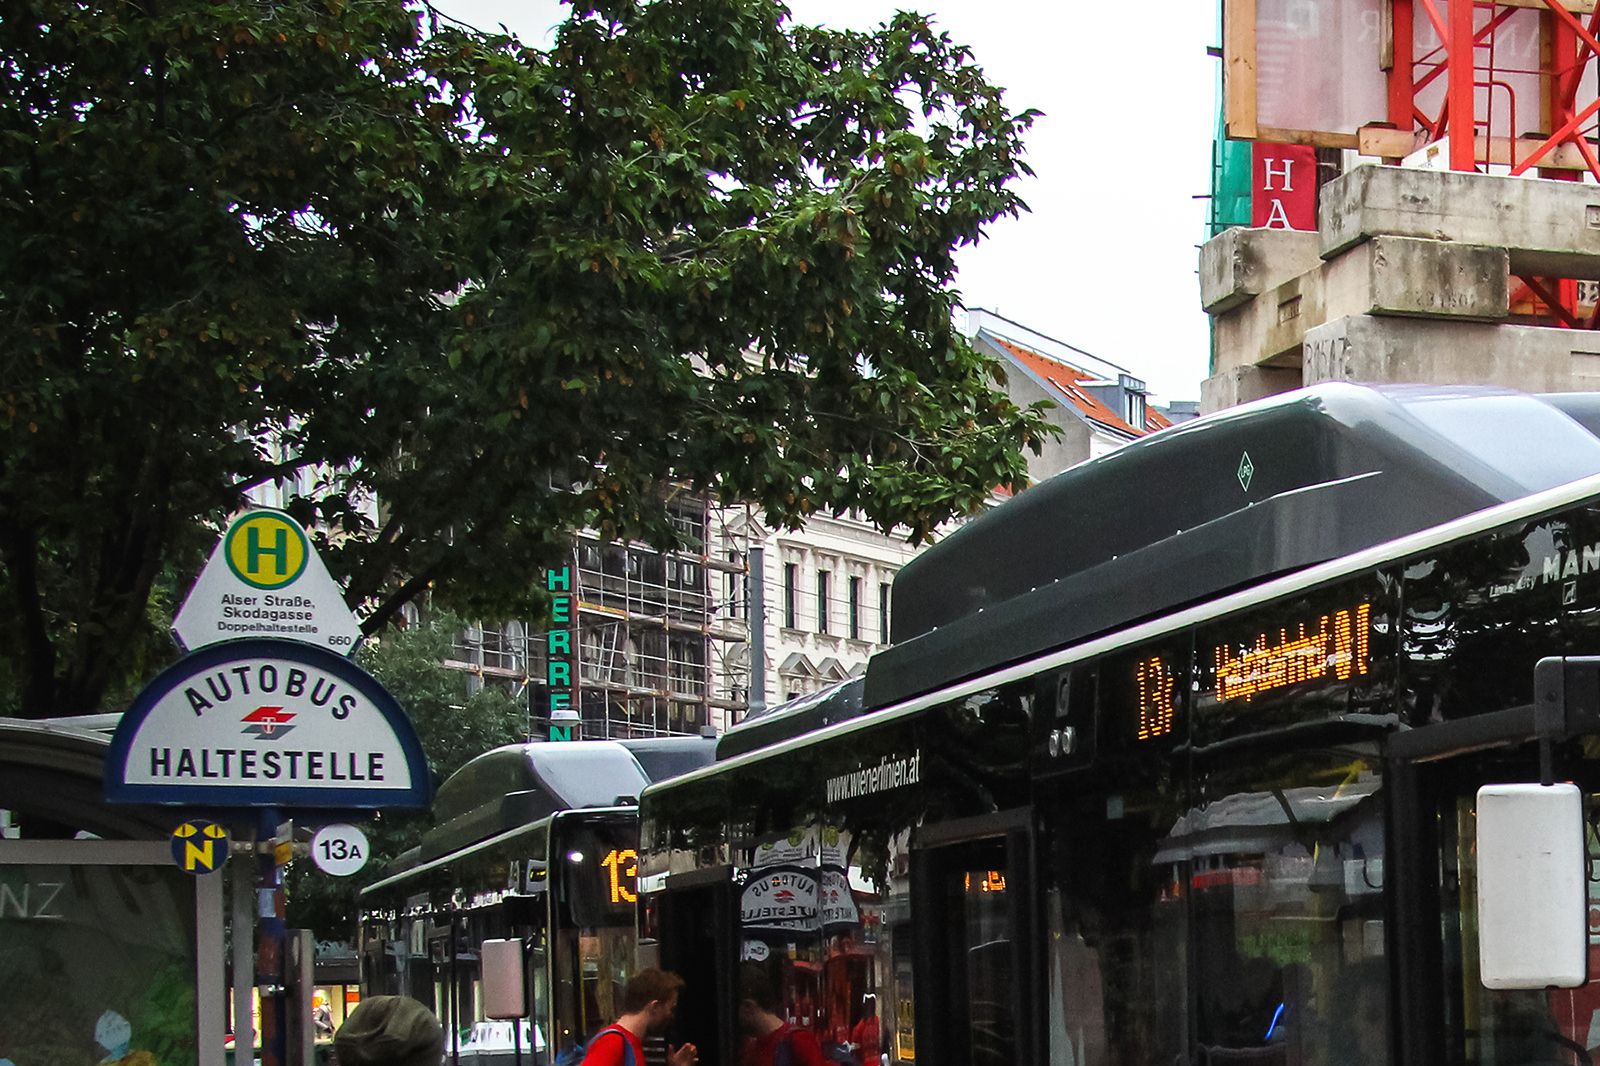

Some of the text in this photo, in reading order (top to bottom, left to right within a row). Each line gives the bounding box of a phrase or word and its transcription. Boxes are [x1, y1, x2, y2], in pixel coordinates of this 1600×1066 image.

[221, 594, 258, 606] Alser
[223, 607, 313, 621] Skodagasse
[218, 621, 318, 634] Doppelhaltestelle
[328, 636, 351, 645] 660
[184, 664, 357, 720] AUTOBUS
[151, 748, 384, 781] HALTESTELLE
[827, 748, 920, 803] www.wienerlinien.at
[319, 840, 361, 860] 13A
